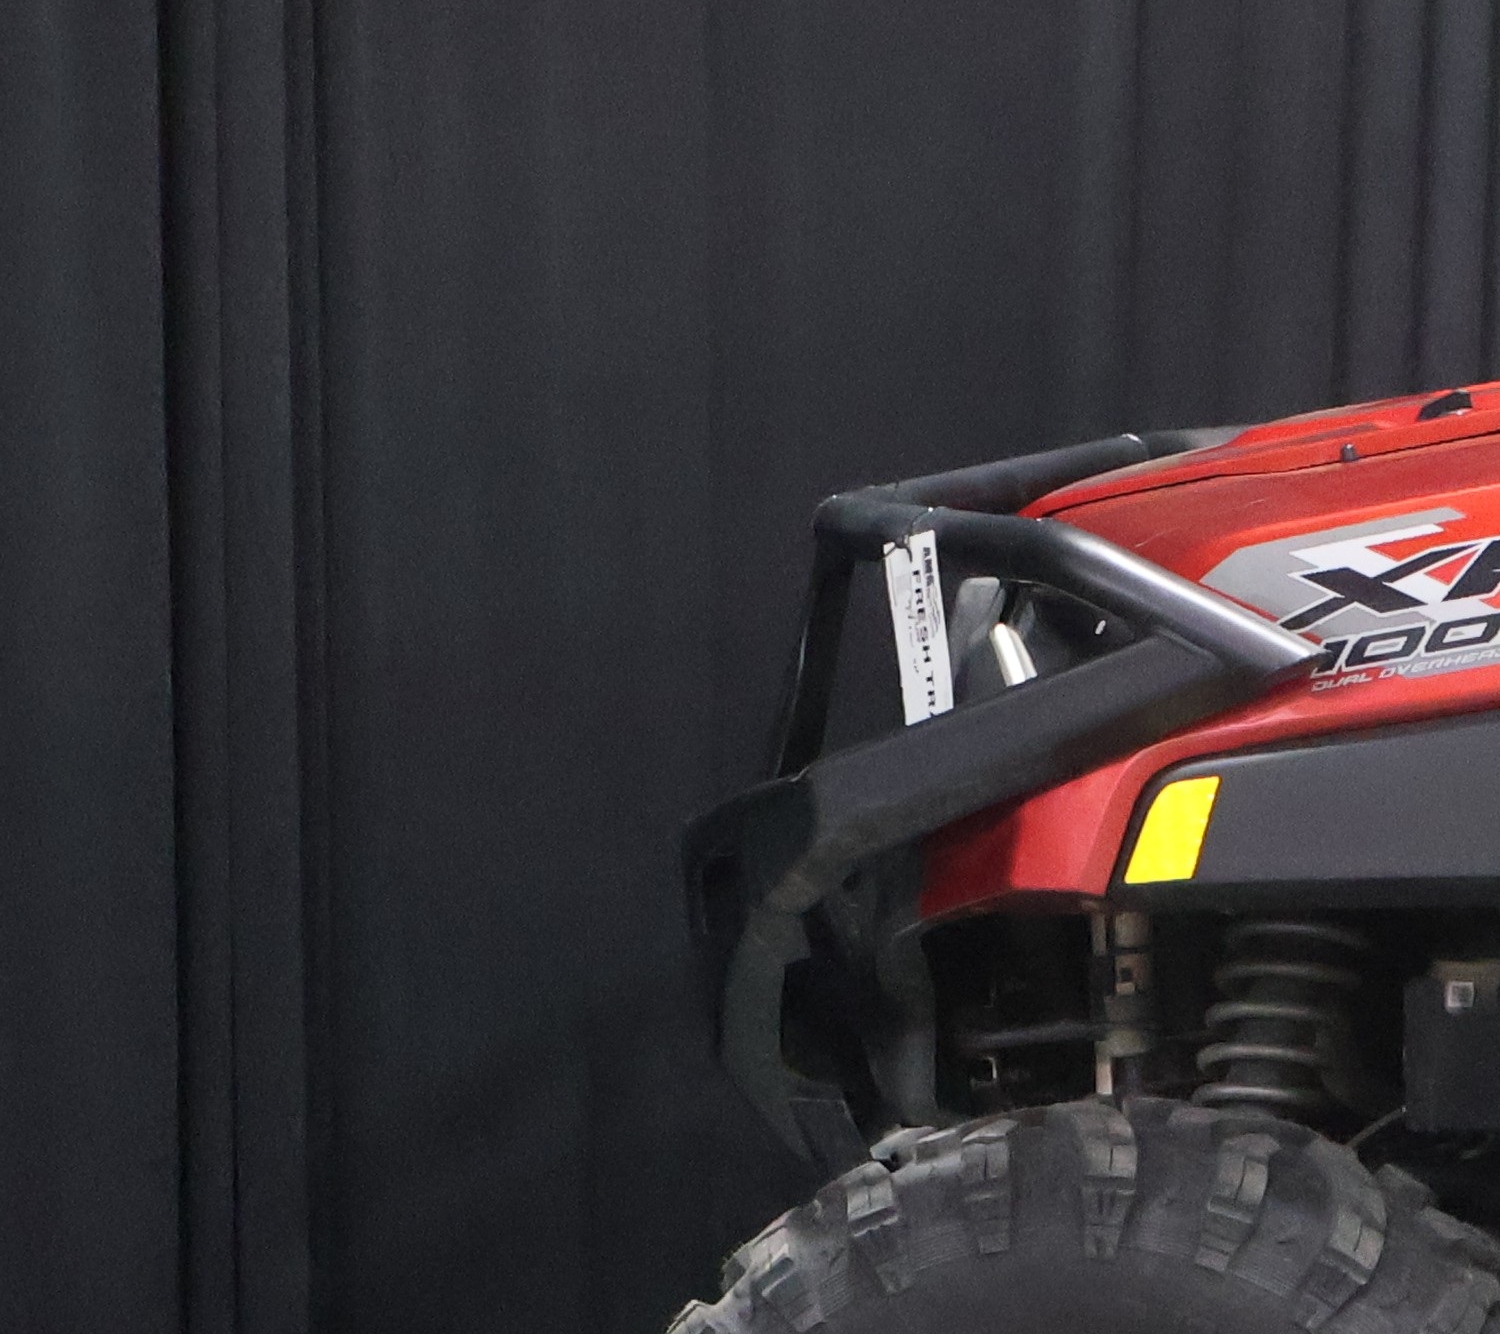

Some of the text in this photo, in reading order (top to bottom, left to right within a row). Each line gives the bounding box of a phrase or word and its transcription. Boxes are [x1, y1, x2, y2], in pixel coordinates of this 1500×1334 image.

[912, 569, 932, 664] FRESH
[925, 671, 937, 717] TR
[1311, 672, 1373, 692] DUAL
